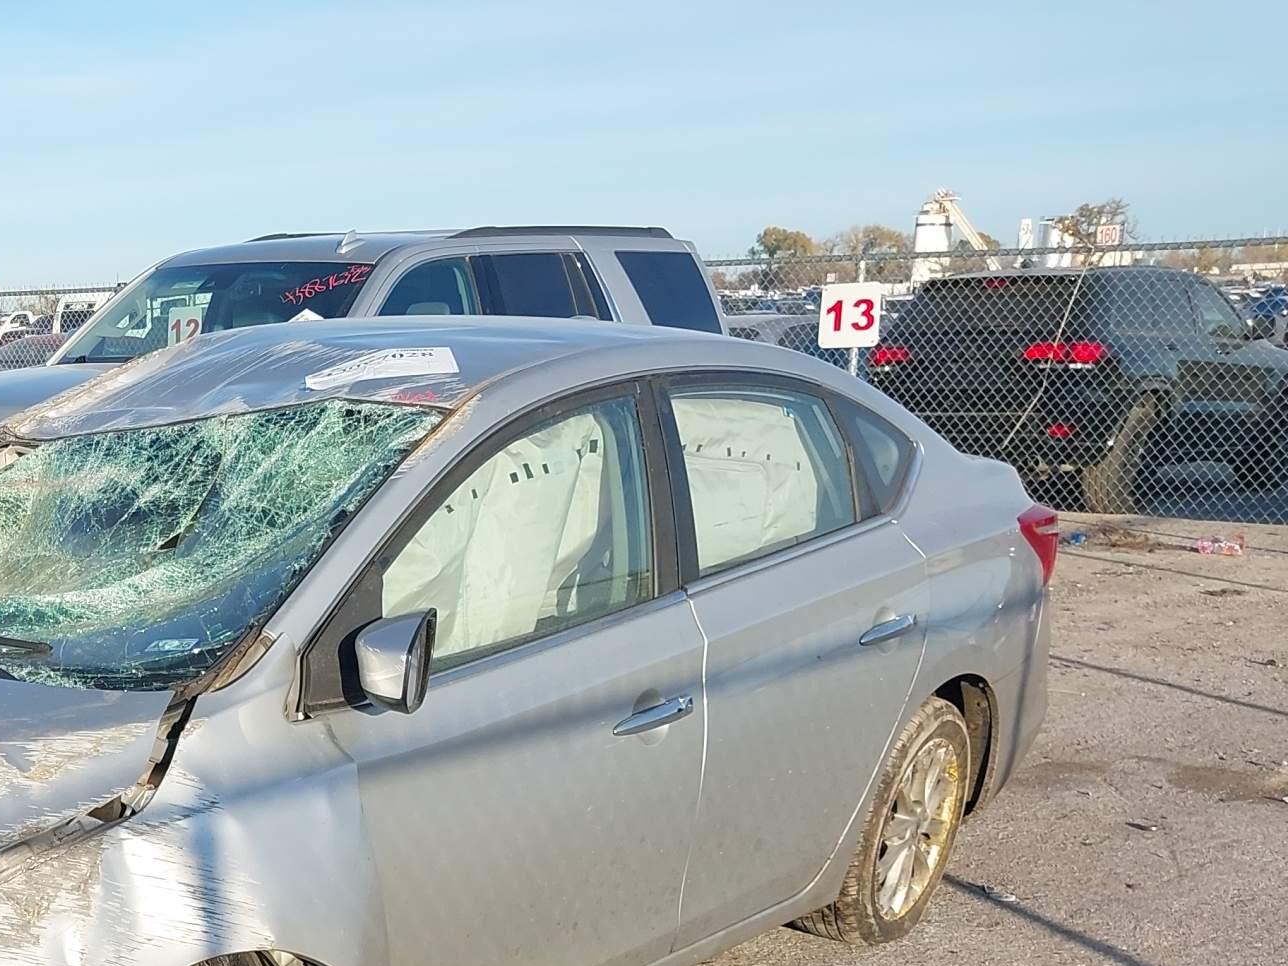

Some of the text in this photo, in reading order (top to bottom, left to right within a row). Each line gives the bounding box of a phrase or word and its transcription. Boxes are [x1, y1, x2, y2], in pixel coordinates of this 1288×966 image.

[1099, 226, 1117, 243] 160
[825, 298, 875, 332] 13
[171, 318, 199, 343] 12
